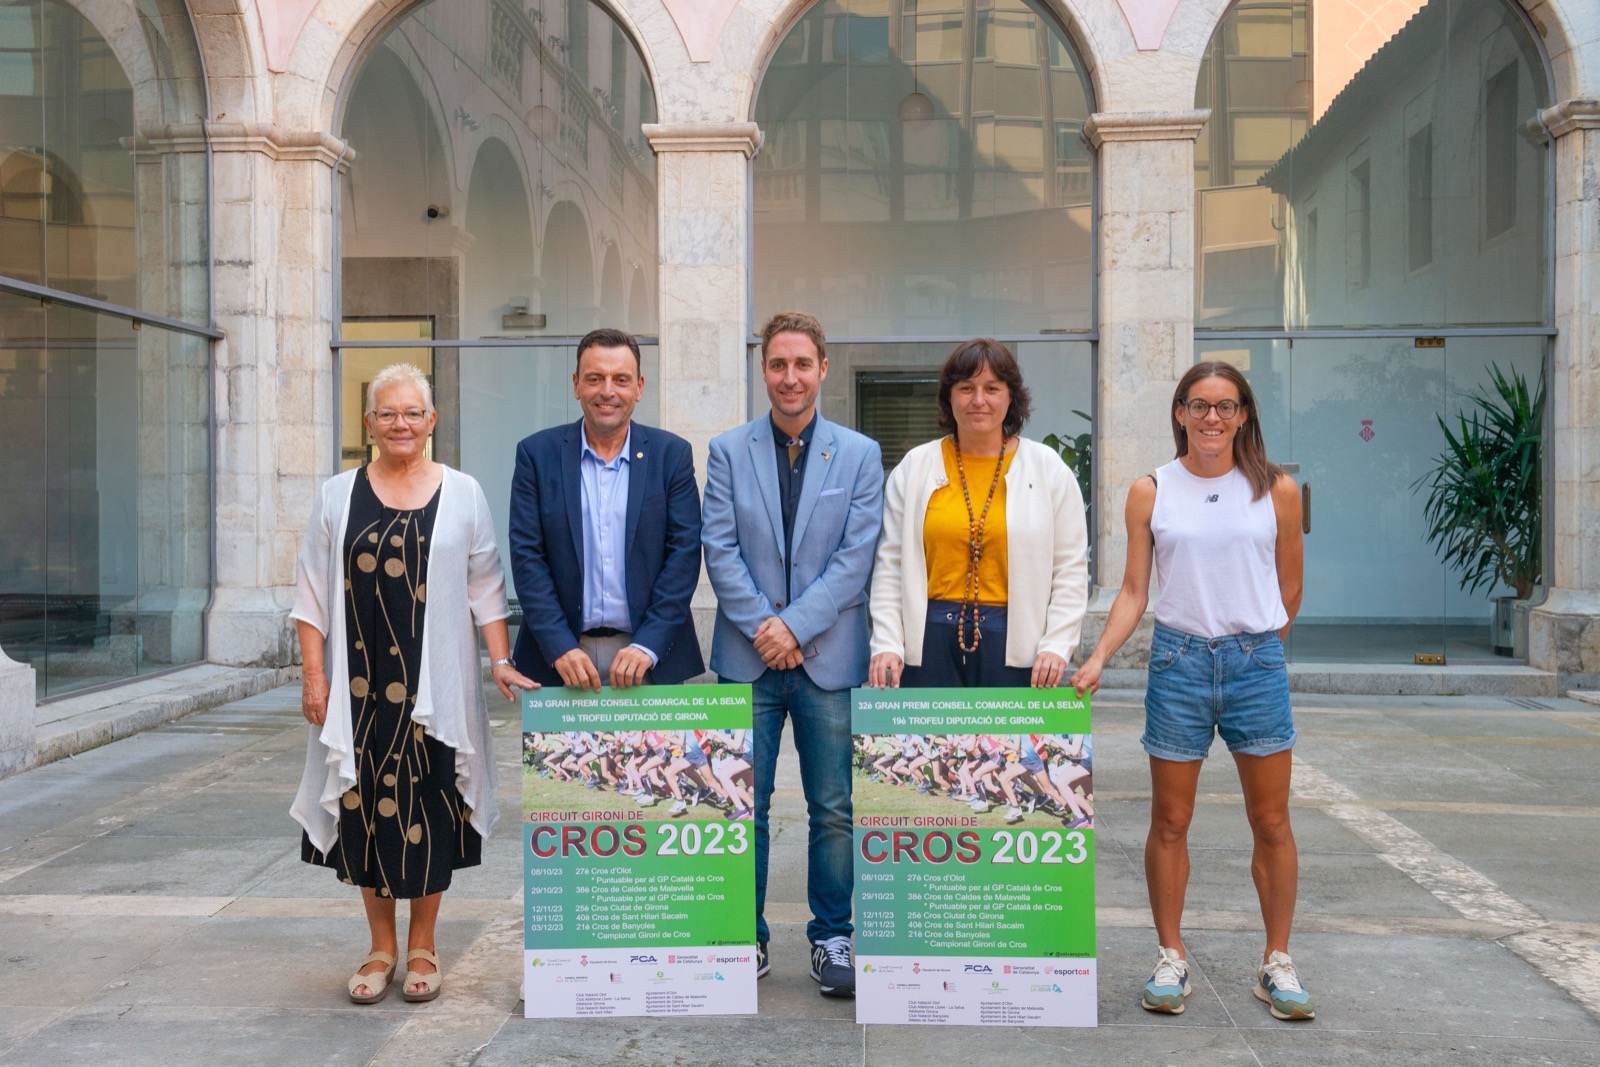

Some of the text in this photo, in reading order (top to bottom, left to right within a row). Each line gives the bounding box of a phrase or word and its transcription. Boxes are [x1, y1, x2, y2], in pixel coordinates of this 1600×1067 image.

[545, 700, 570, 708] GRAN
[572, 699, 598, 707] PREMI
[601, 699, 640, 707] CONSELL
[642, 698, 690, 706] COMARCAL
[720, 697, 746, 705] SELVA
[975, 701, 1025, 709] COMARCAL
[1028, 701, 1040, 709] DE
[1043, 701, 1055, 709] LA
[1057, 701, 1084, 709] SELVA
[578, 714, 612, 722] TROFEU
[614, 712, 658, 722] DIPUTACIÓ
[661, 713, 672, 721] DE
[946, 715, 992, 724] DIPUTACIÓ
[530, 812, 578, 821] CIRCUIT
[628, 811, 643, 820] DE
[860, 816, 909, 826] CIRCUIT
[962, 817, 977, 826] DE
[530, 823, 748, 859] CROS 2023
[860, 830, 1087, 865] CROS 2023
[622, 923, 655, 931] Banyoles
[597, 932, 636, 940] Campionat
[863, 930, 895, 938] 03/12/23
[956, 931, 990, 939] Banyoles
[930, 940, 970, 948] Campionat
[716, 956, 750, 964] esportcat
[1054, 968, 1090, 976] esportcat
